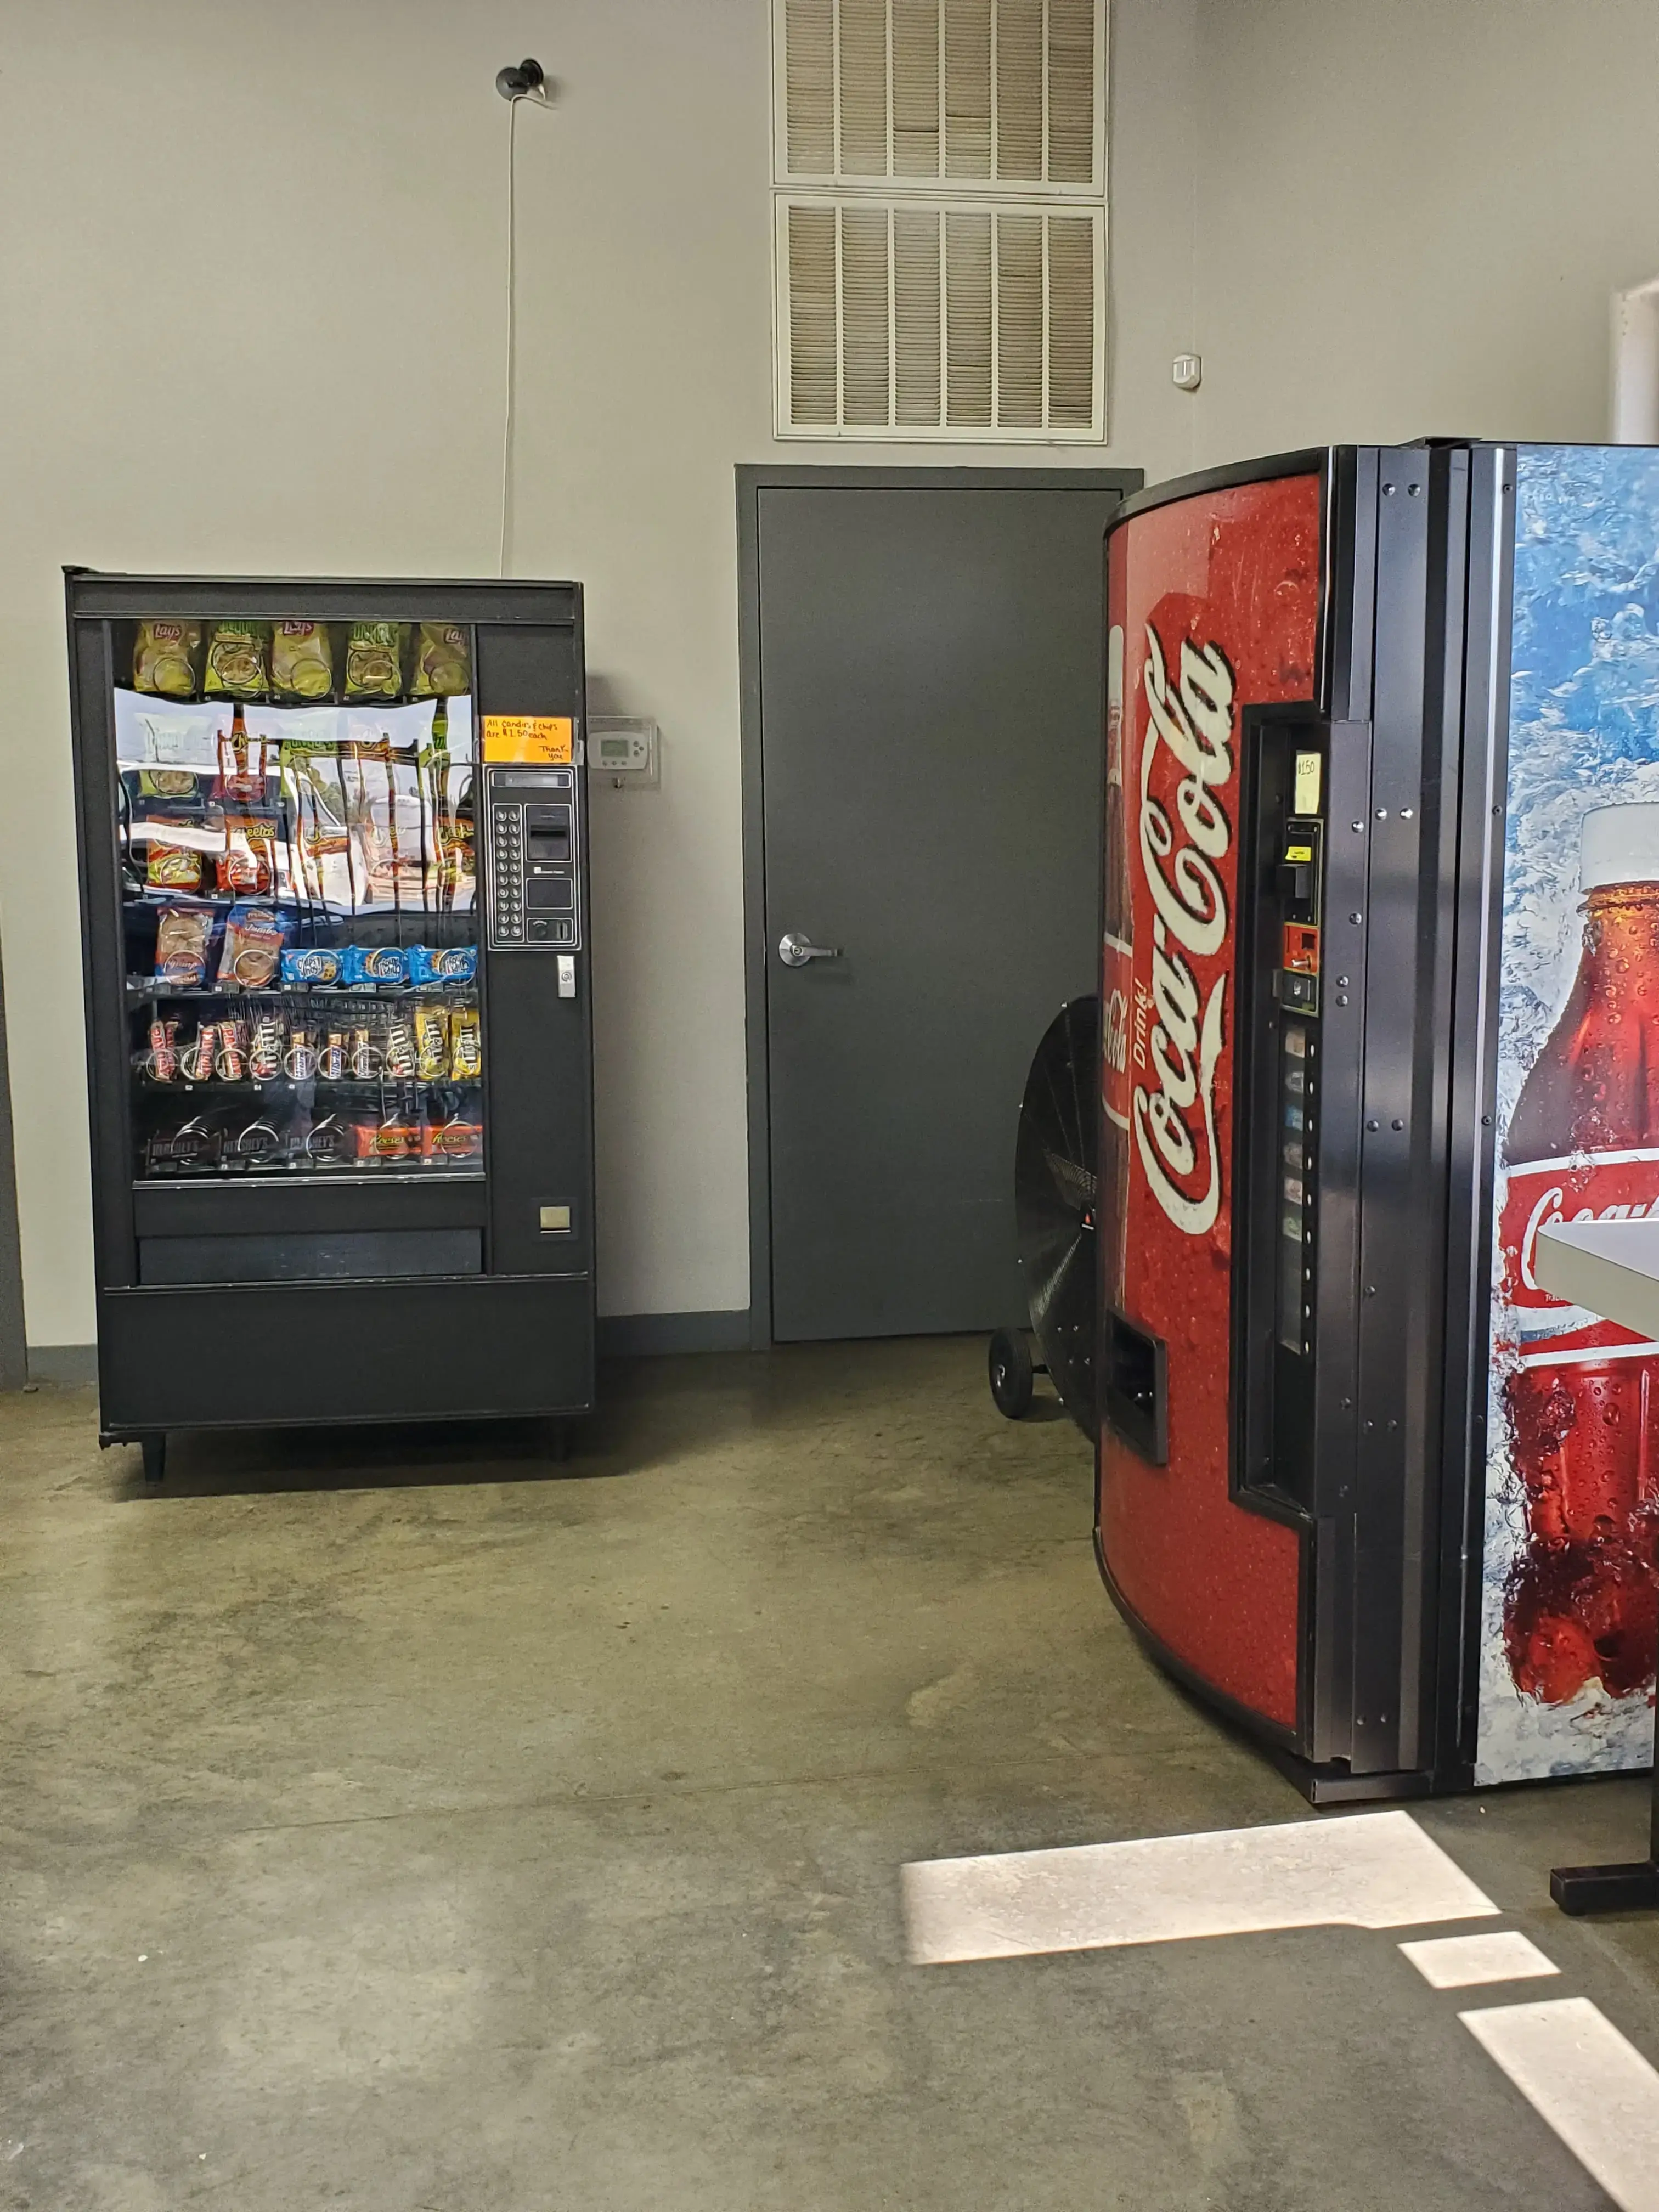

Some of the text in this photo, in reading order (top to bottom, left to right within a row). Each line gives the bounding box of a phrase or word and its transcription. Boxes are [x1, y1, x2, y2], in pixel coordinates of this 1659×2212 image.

[538, 723, 558, 731] chips
[1134, 623, 1235, 1234] Coca-Cola
[1133, 978, 1147, 1070] Drink!
